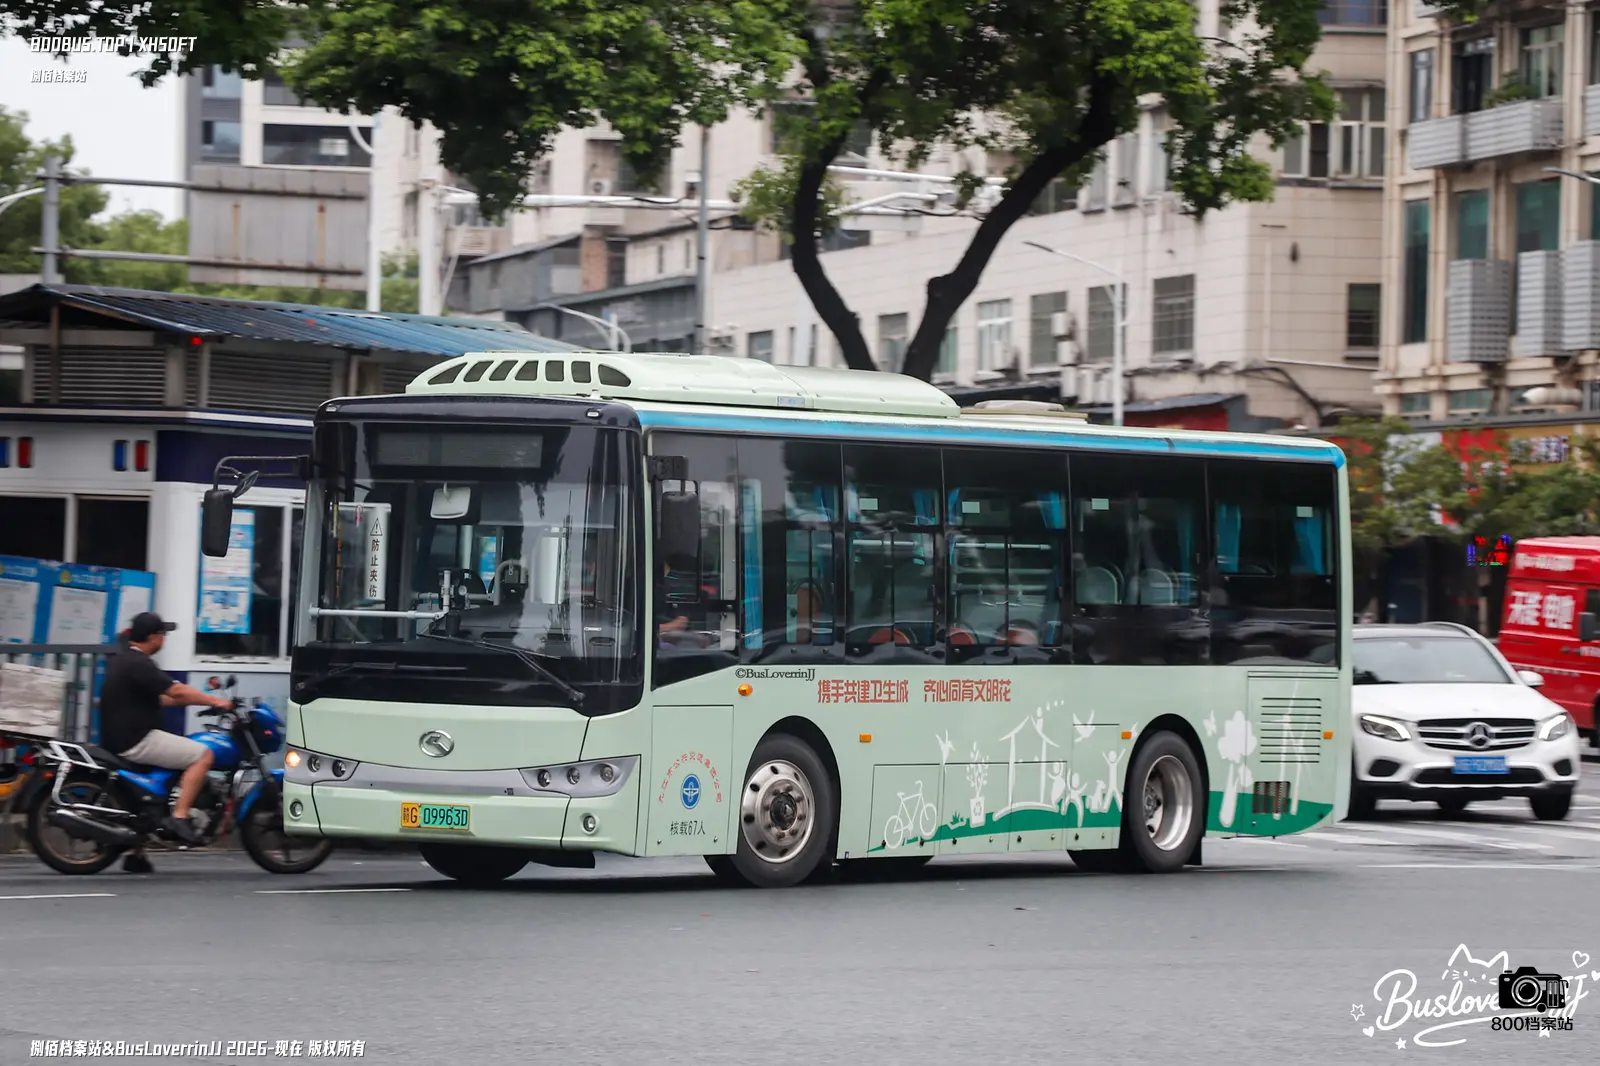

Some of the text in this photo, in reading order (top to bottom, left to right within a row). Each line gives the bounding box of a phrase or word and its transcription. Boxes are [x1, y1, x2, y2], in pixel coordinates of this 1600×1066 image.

[369, 539, 380, 597] 防止夹伤
[817, 679, 1012, 703] 携手共建卫生城 齐心同育文明花
[670, 820, 706, 836] 核载67人
